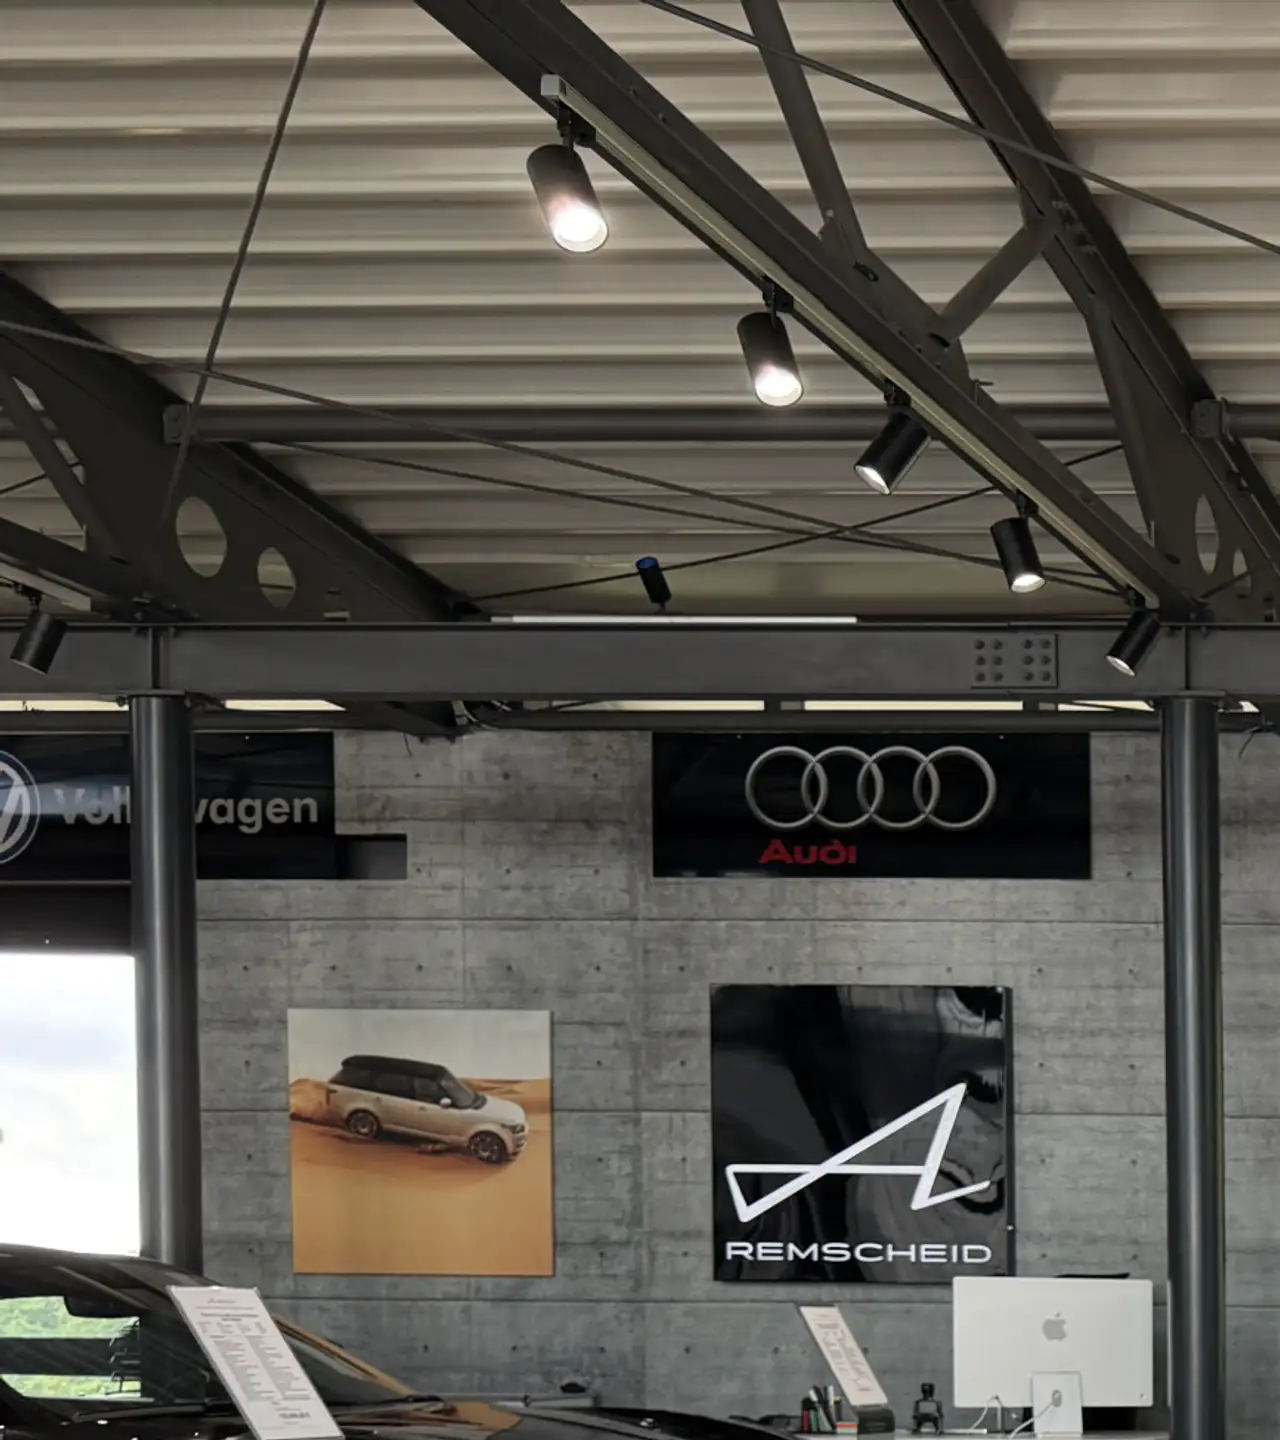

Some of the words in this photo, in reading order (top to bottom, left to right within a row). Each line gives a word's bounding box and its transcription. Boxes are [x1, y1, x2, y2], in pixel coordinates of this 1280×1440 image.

[55, 785, 318, 834] Volagen
[758, 839, 858, 865] Audi
[725, 1241, 992, 1264] REMSCHEID
